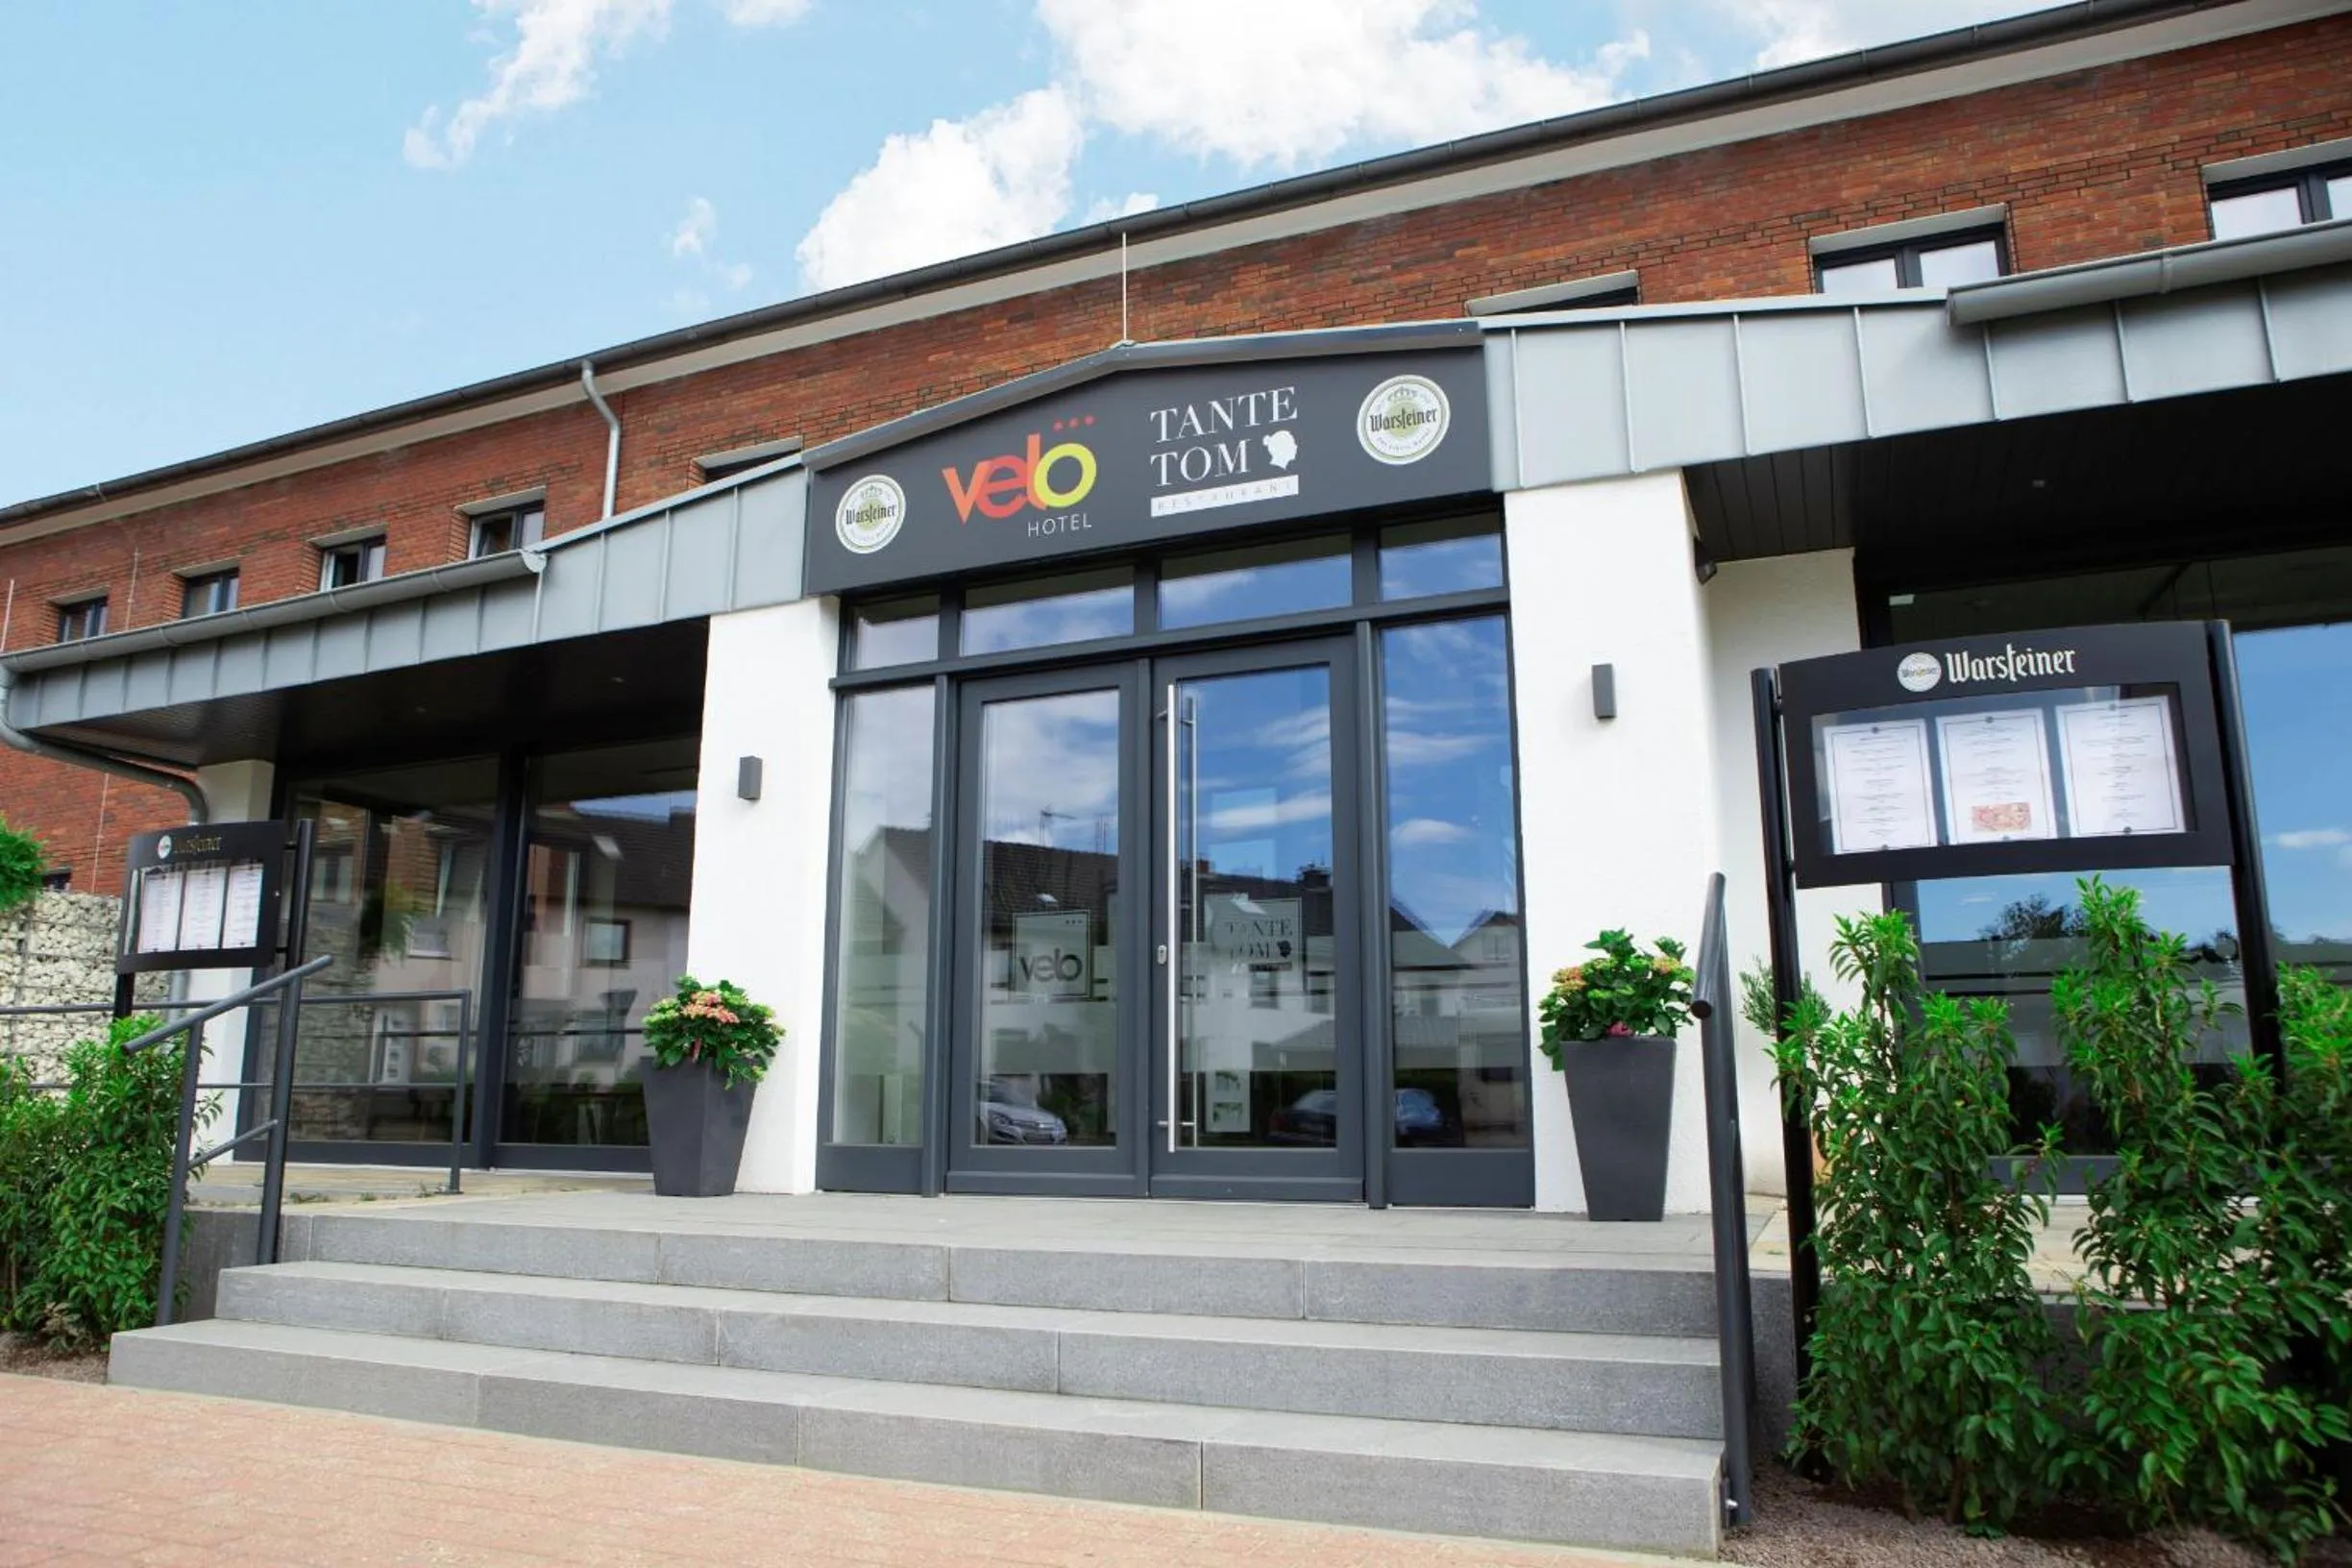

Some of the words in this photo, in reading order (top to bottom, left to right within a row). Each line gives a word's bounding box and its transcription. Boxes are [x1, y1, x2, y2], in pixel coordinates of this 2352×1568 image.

[1150, 386, 1297, 443] TANTE
[1370, 406, 1437, 432] Warsteiner
[941, 432, 1097, 525] velo
[1150, 438, 1252, 487] TOM
[845, 503, 895, 526] Warsteiner
[1027, 513, 1092, 537] HOTEL
[1946, 643, 2076, 684] Warsteiner
[1019, 947, 1083, 983] velo
